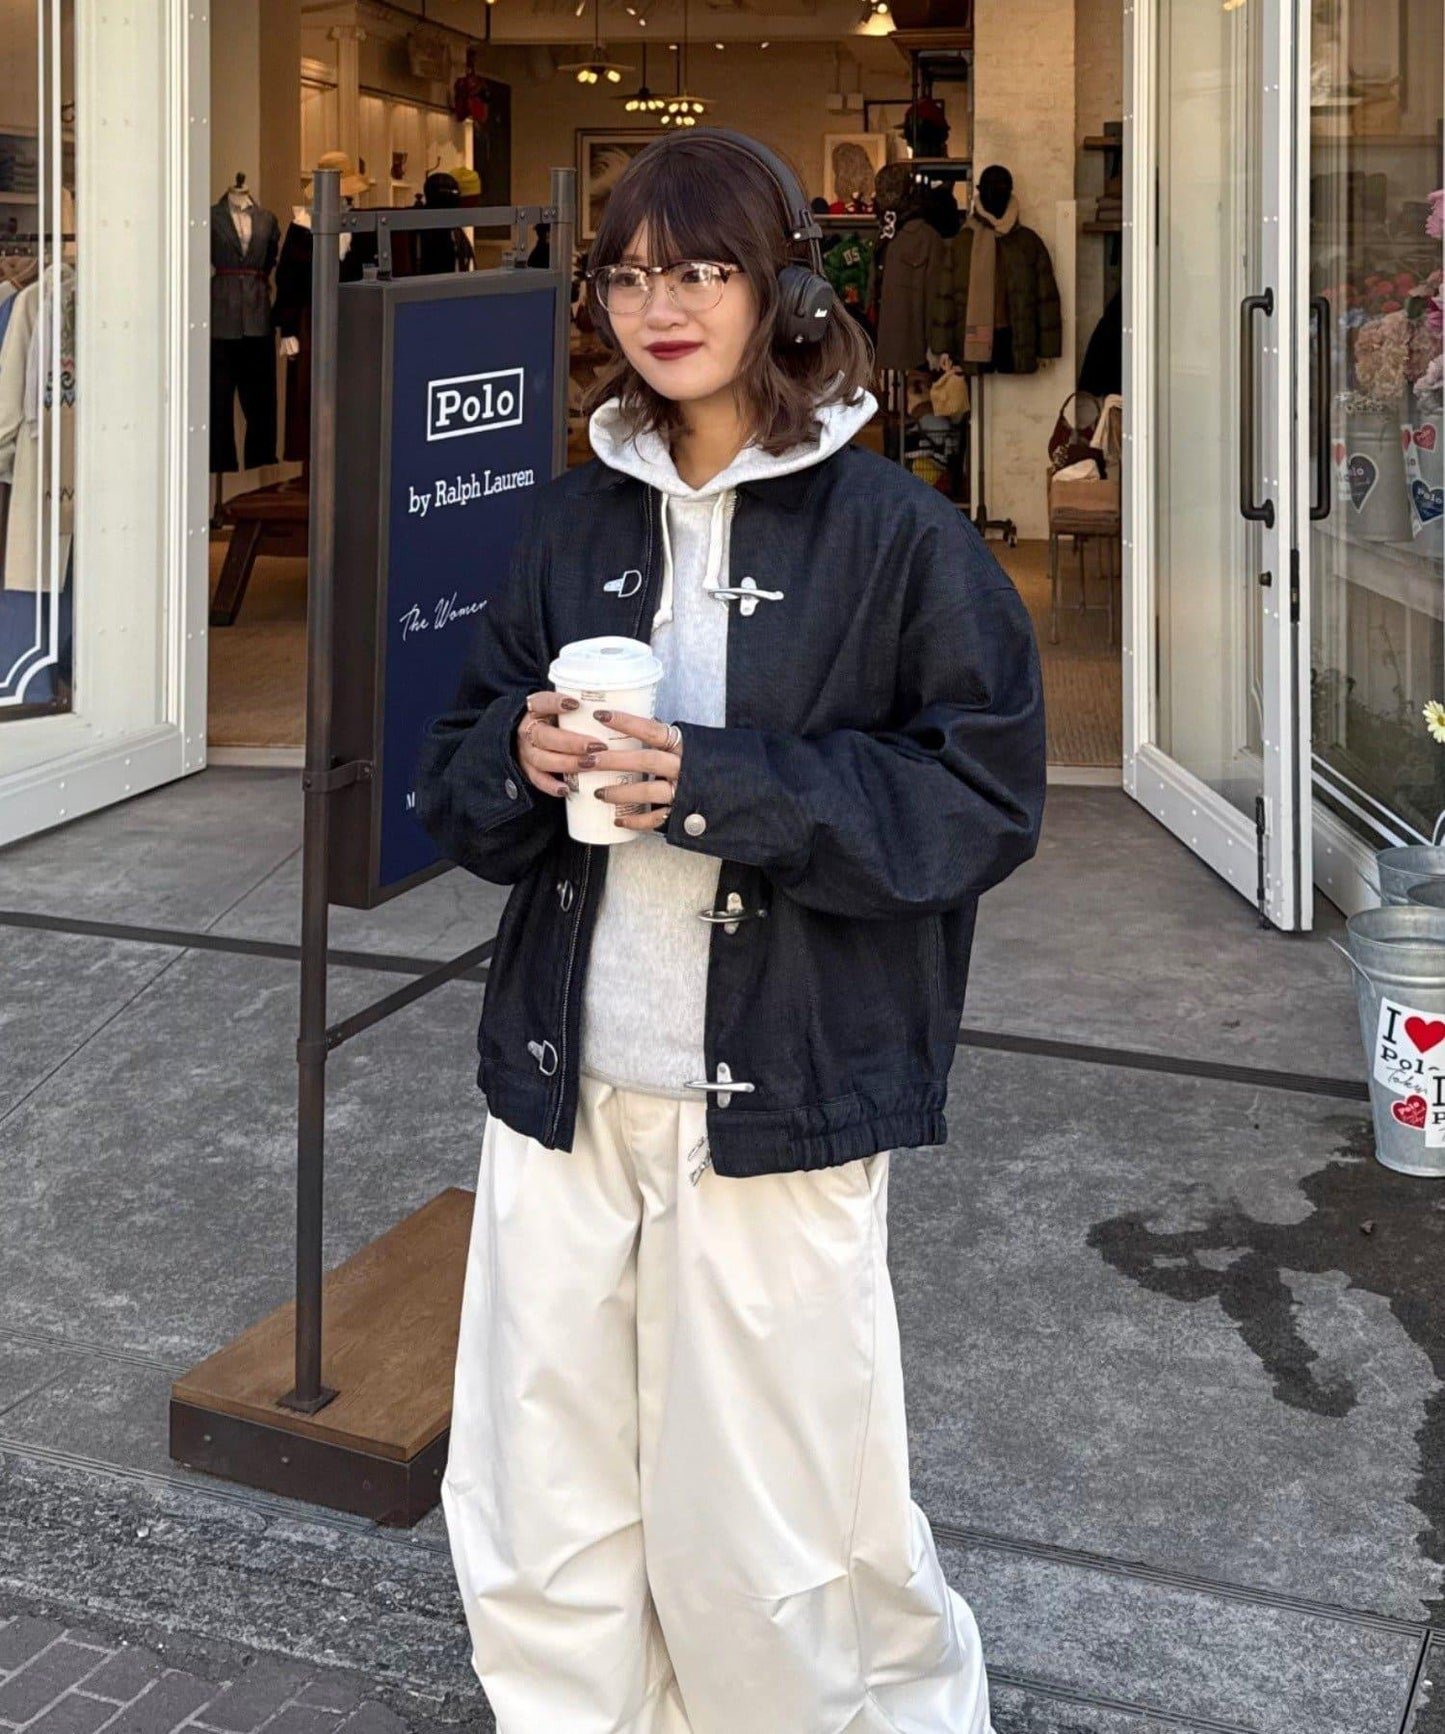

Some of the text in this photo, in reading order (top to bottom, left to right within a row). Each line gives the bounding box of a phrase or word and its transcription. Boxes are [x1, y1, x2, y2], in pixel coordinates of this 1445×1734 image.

[435, 383, 515, 428] Polo
[408, 468, 535, 517] by Ralph Lauren
[399, 603, 430, 641] The
[1382, 1006, 1402, 1045] I
[1380, 1044, 1440, 1076] Pol
